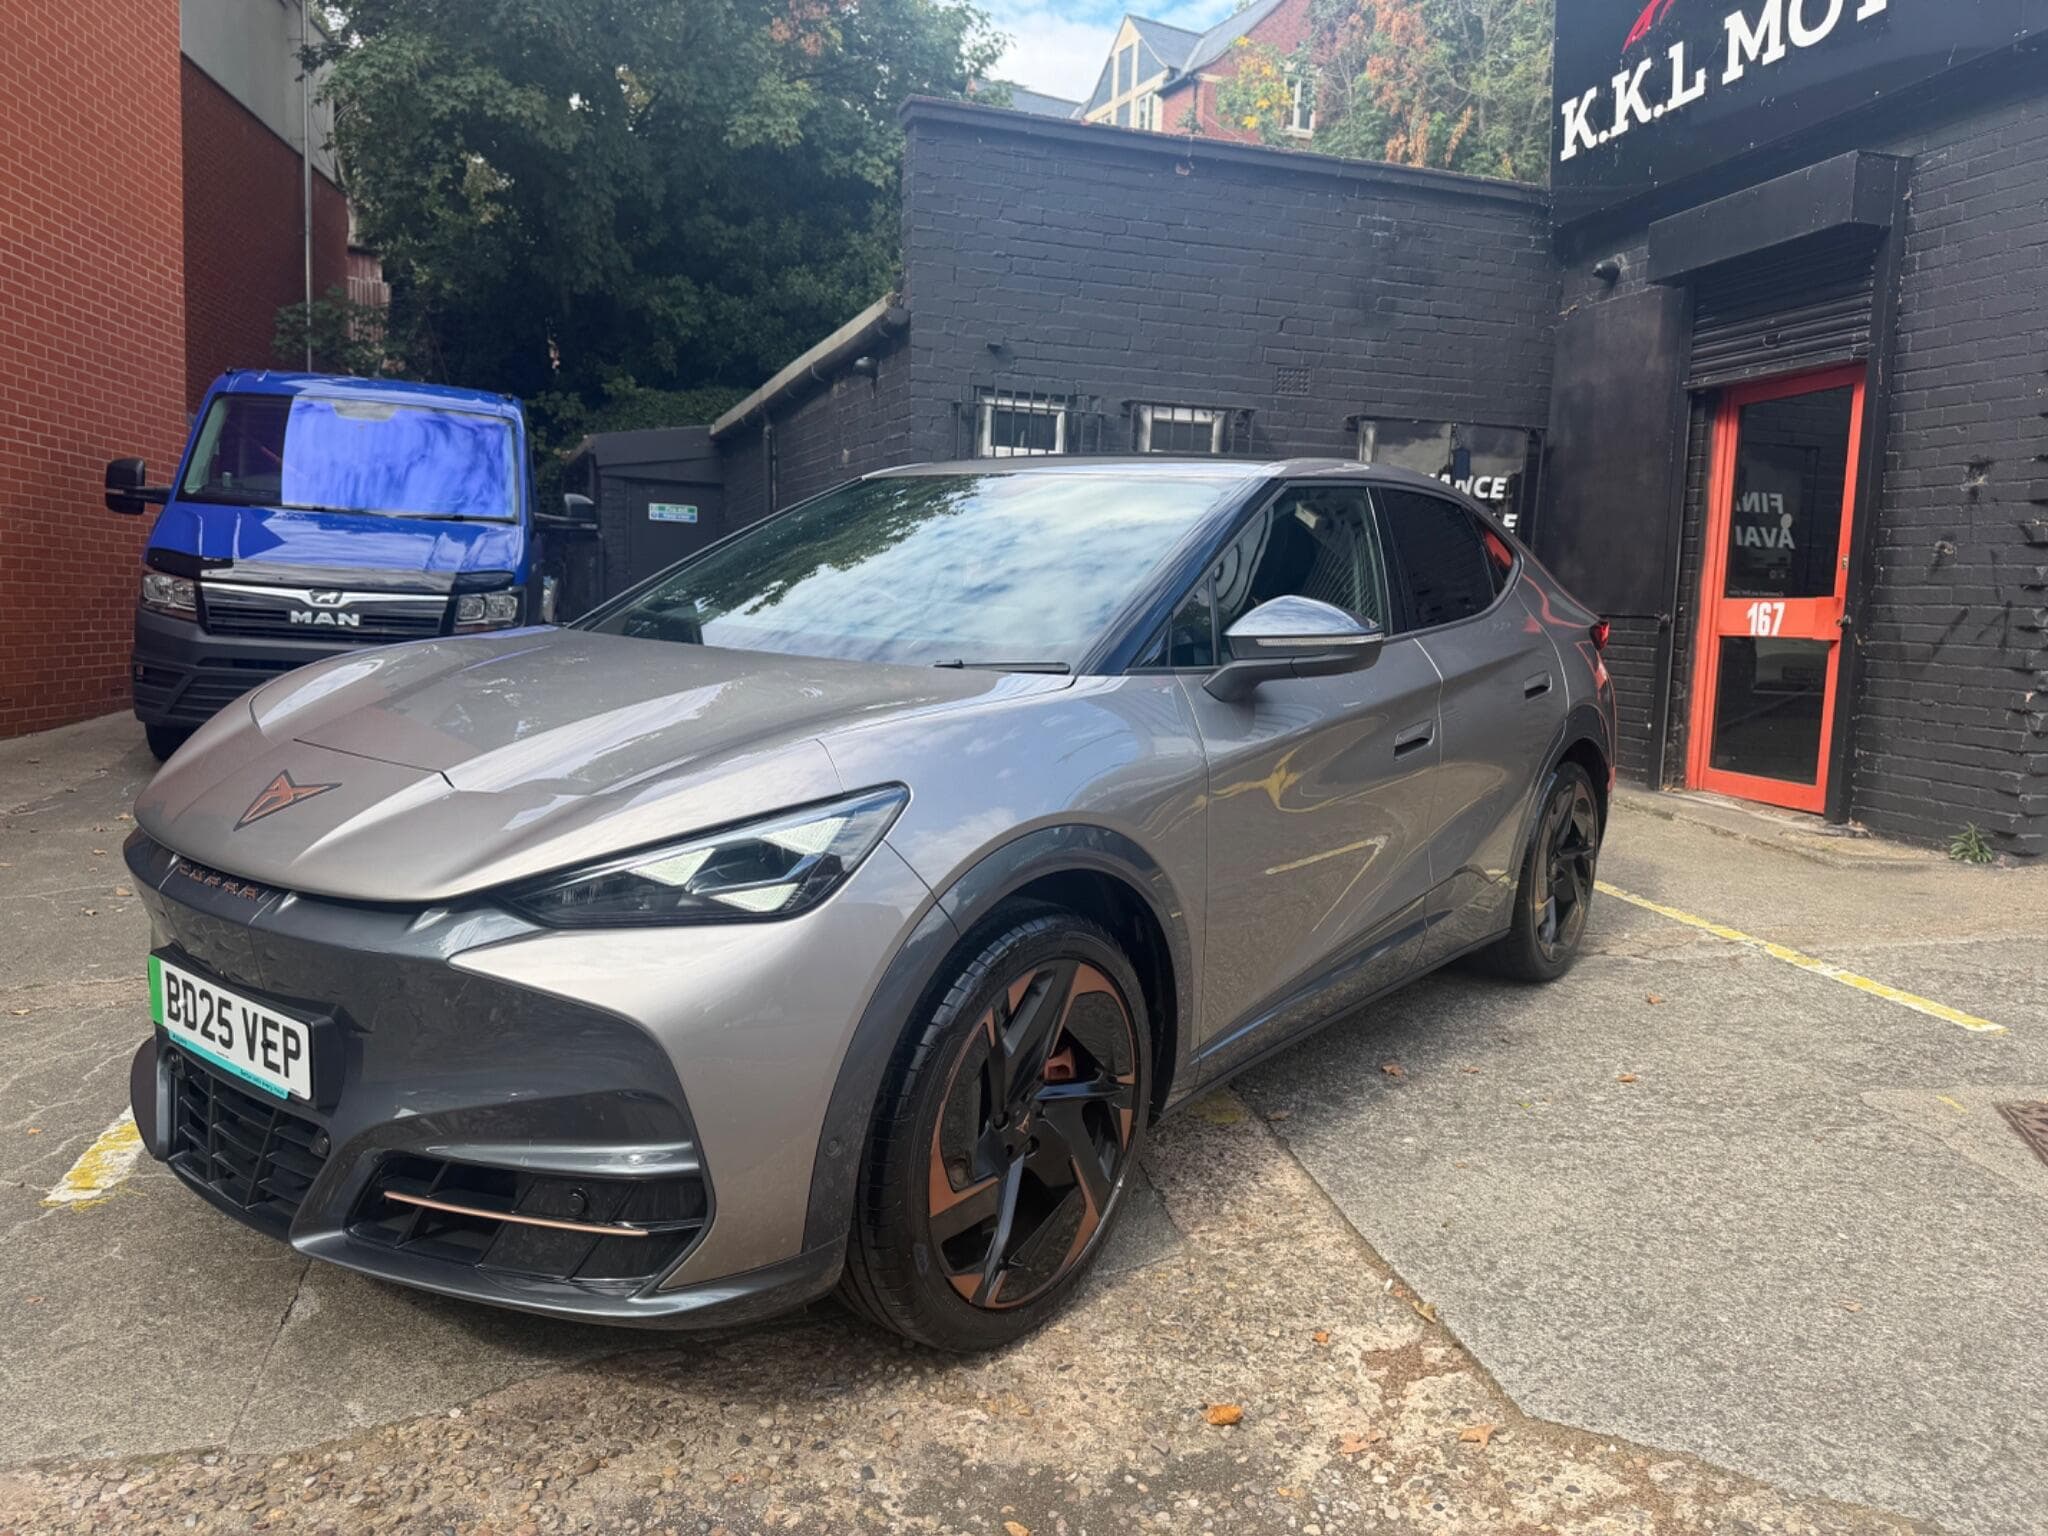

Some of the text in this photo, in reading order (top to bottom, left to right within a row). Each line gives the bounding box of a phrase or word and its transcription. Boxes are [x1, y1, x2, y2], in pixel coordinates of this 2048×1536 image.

[289, 610, 360, 627] MAN
[1746, 601, 1786, 637] 167
[164, 970, 302, 1079] BD25 VEP
